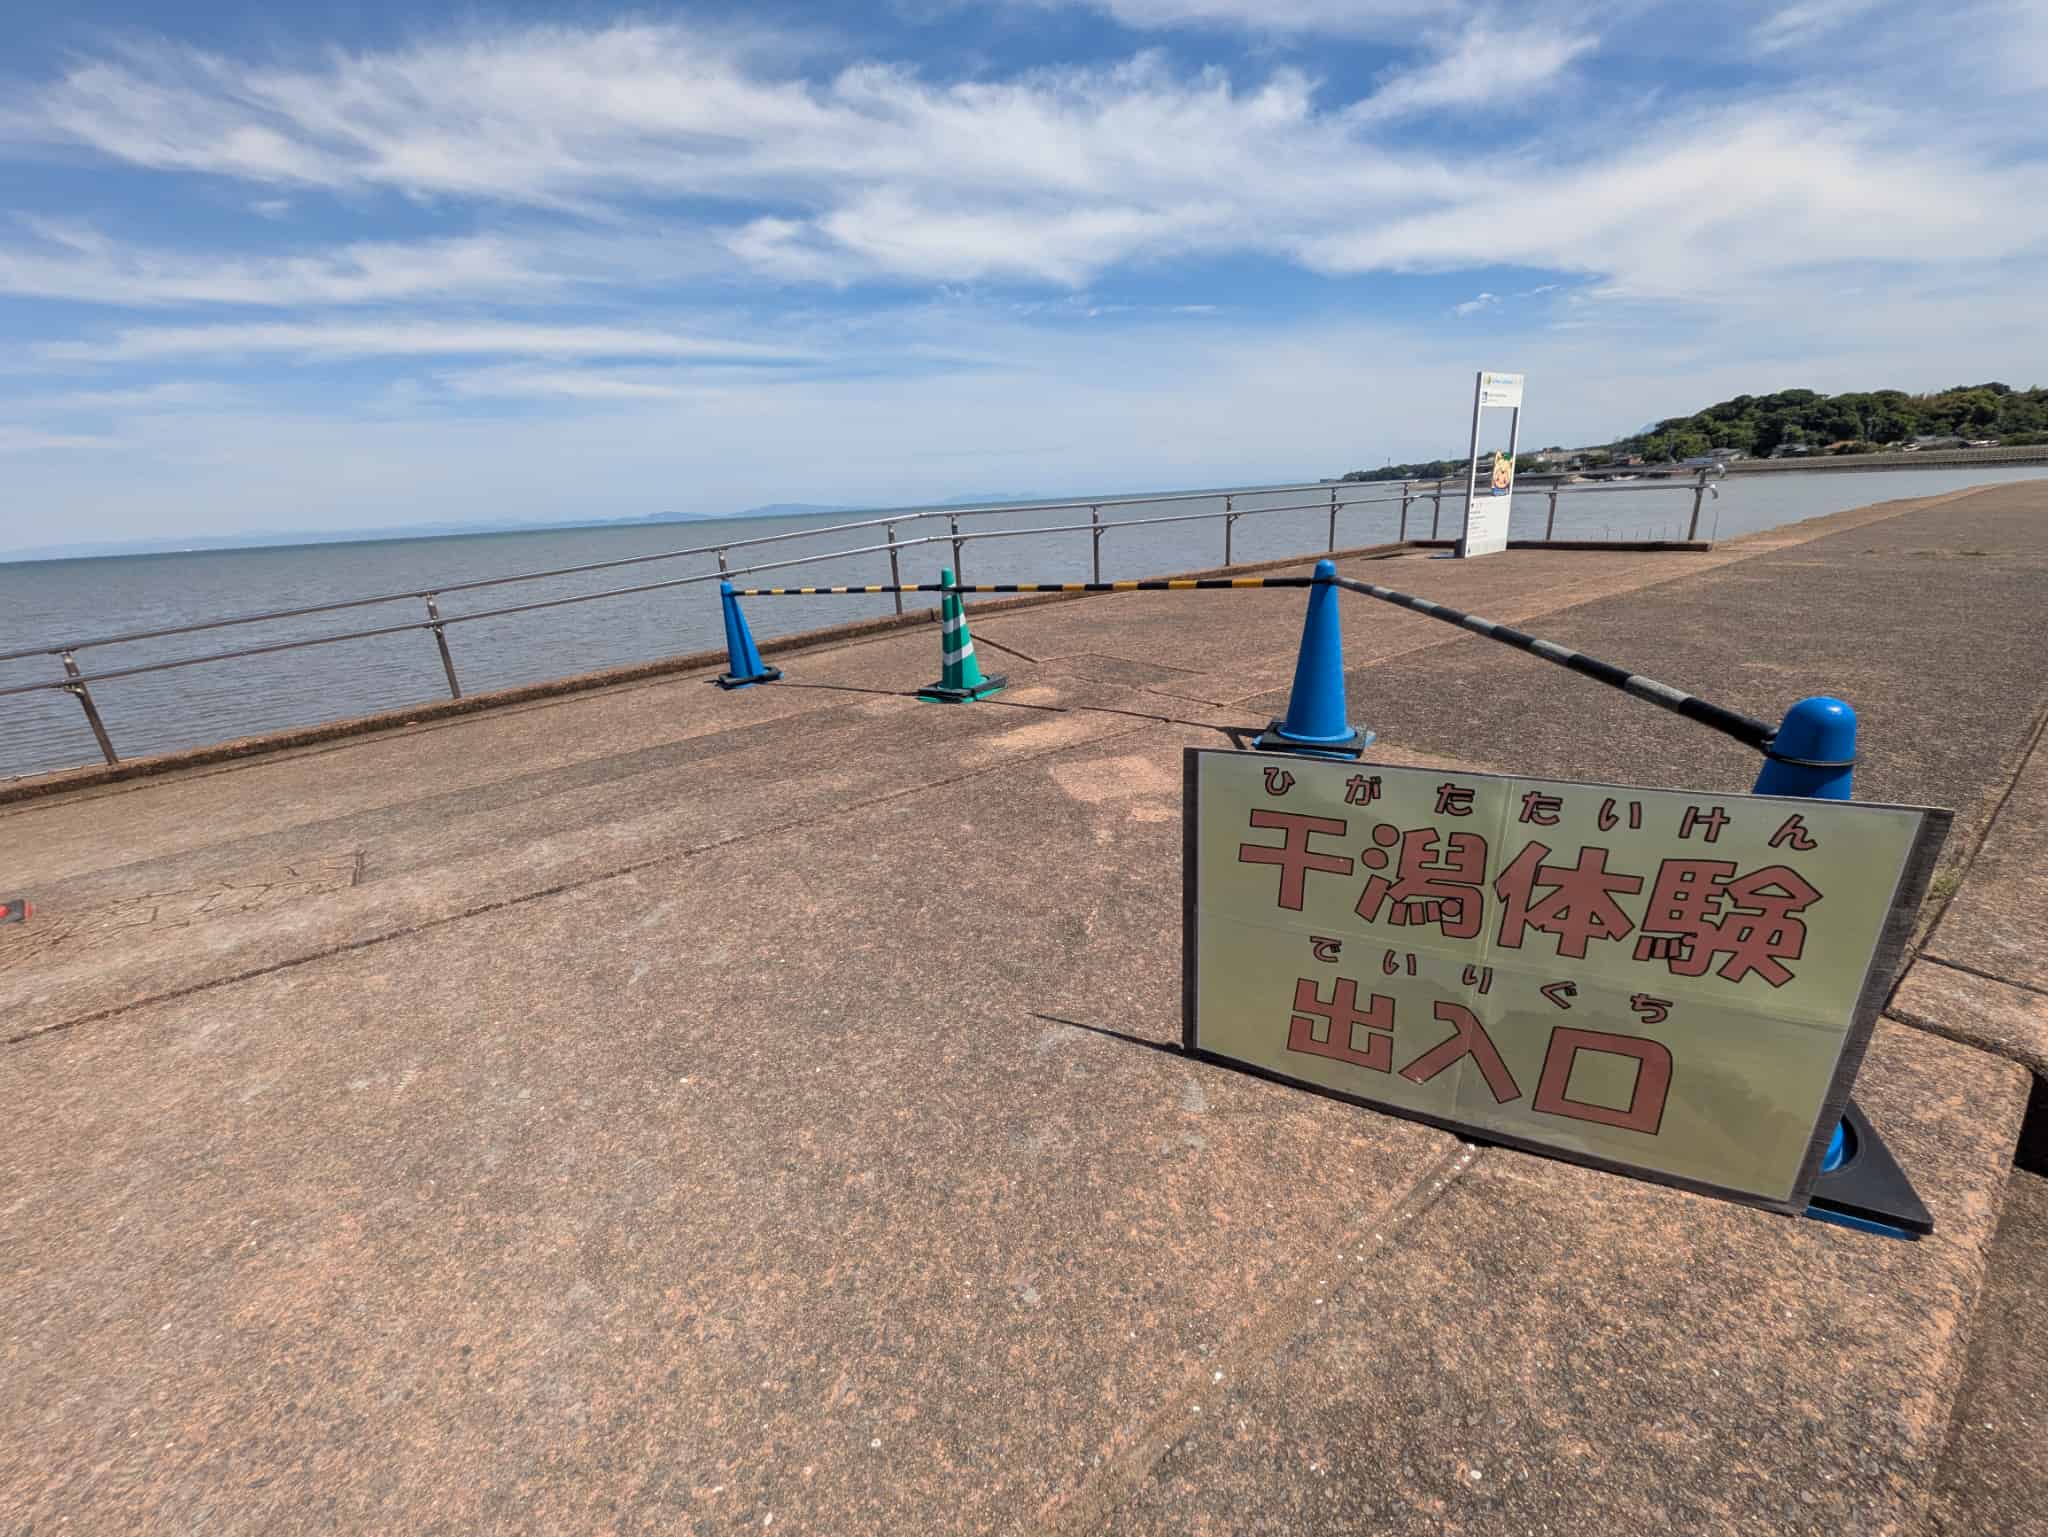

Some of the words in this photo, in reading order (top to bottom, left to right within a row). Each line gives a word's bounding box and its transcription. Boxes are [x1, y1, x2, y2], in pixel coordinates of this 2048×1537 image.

[1264, 767, 1818, 851] ひがたたいけん
[1238, 808, 1823, 988] 干潟体験
[1310, 935, 1673, 1024] でいりぐち
[1286, 976, 1673, 1136] 出入口
